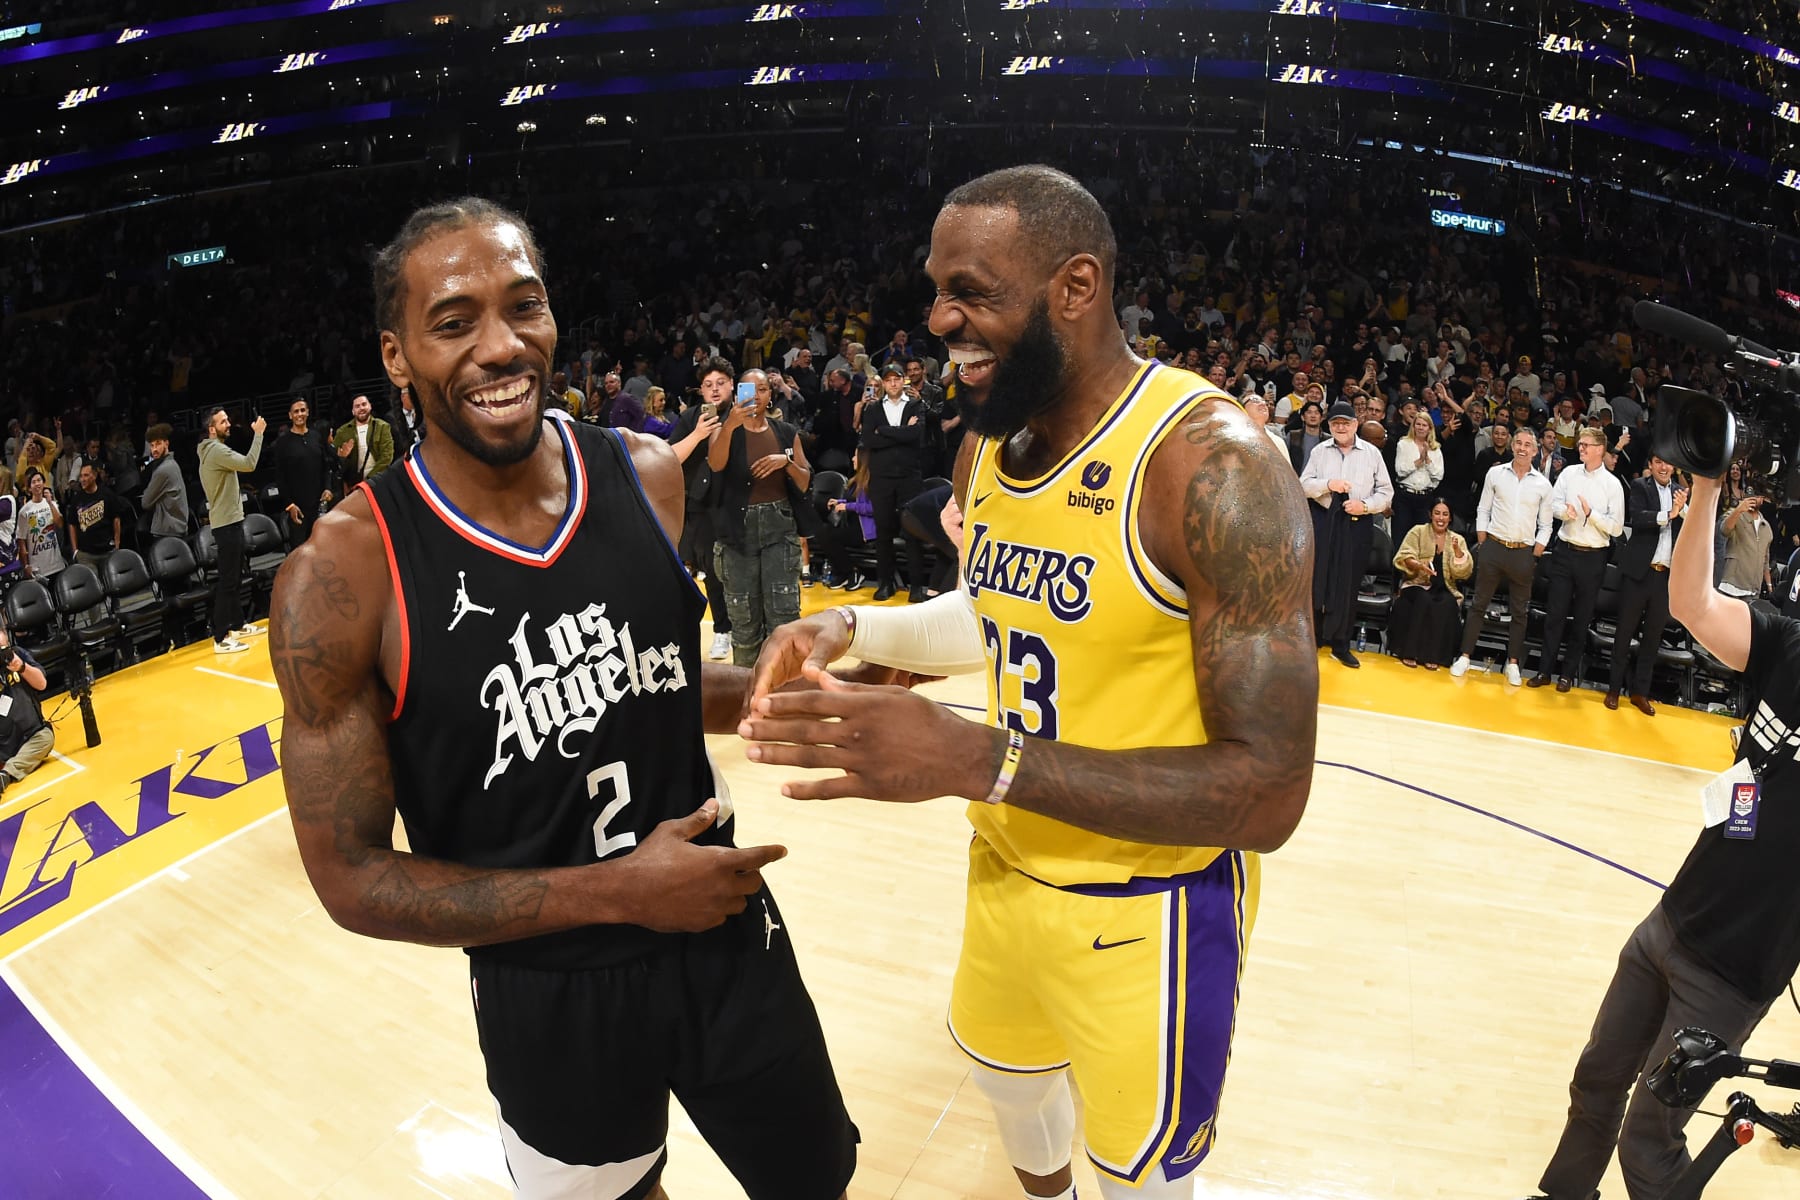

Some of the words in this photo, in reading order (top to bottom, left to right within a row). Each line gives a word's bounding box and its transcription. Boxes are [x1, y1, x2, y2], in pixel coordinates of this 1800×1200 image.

[183, 249, 224, 265] DELTA
[1431, 209, 1499, 233] Spectrum
[1067, 490, 1115, 516] bibigo
[963, 521, 1097, 625] LAKERS
[508, 602, 619, 693] Los
[479, 621, 688, 790] Angeles
[586, 760, 637, 858] 2
